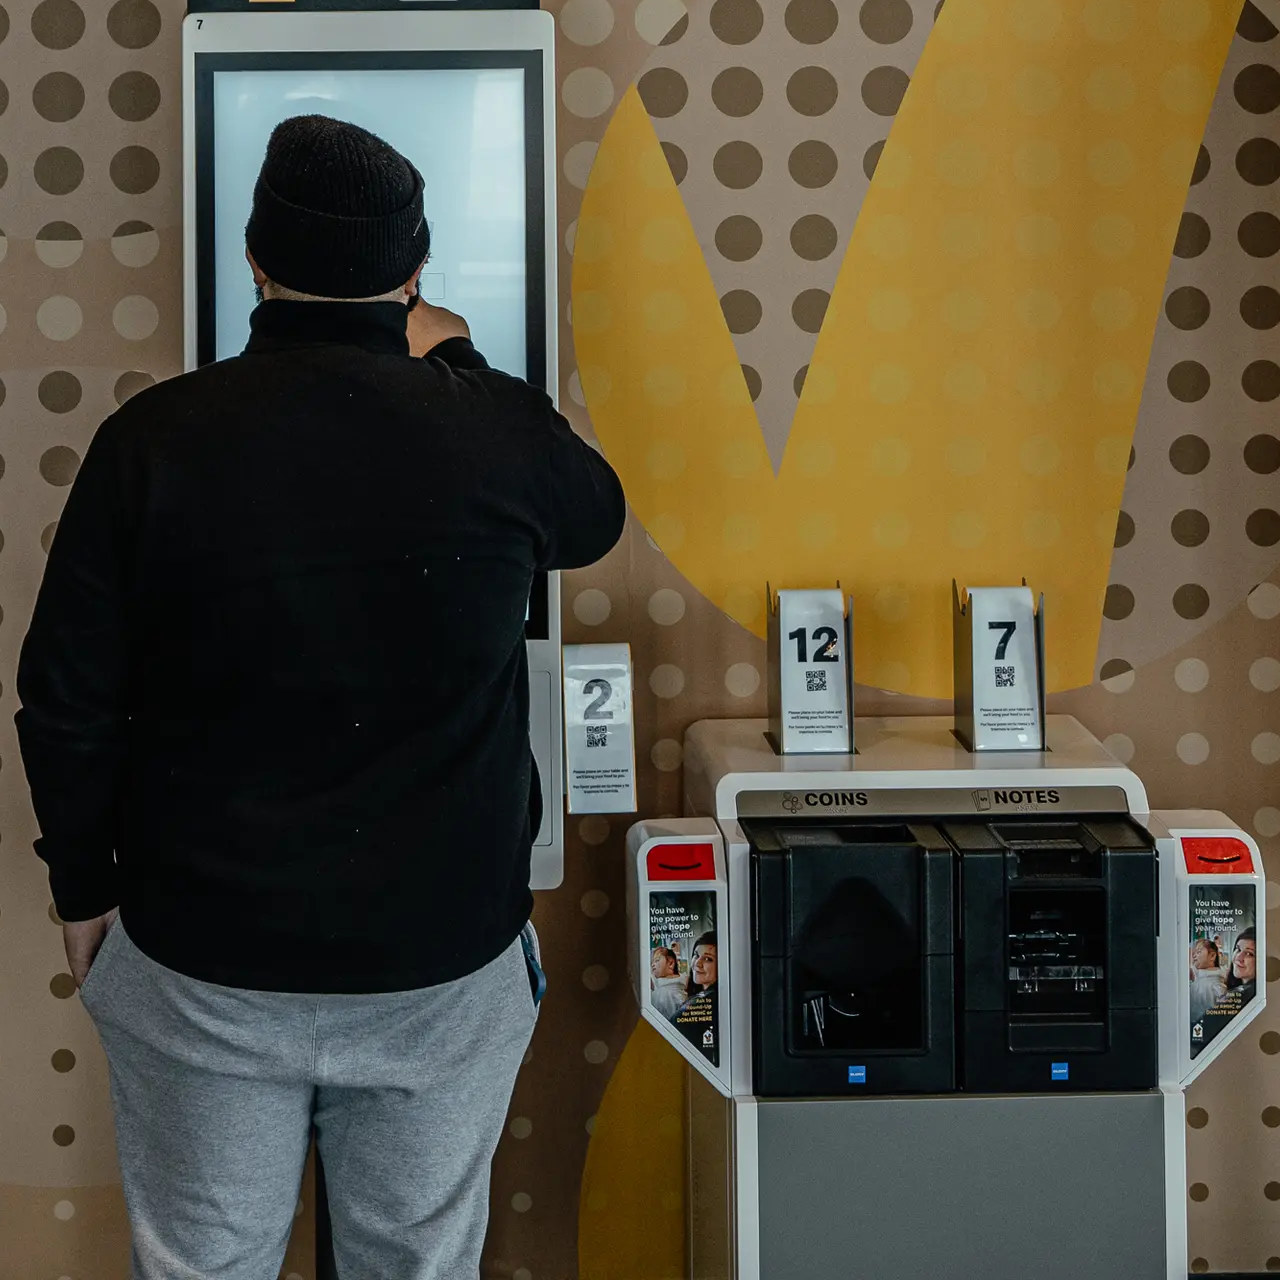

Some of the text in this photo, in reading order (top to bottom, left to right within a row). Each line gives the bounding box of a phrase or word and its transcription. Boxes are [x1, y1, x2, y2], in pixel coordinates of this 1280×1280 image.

[197, 19, 203, 30] 7
[789, 626, 839, 662] 12
[988, 622, 1016, 660] 7
[583, 678, 613, 720] 2
[805, 792, 868, 806] COINS
[994, 790, 1060, 804] NOTES
[1195, 916, 1233, 925] give hope
[651, 923, 690, 933] give hope
